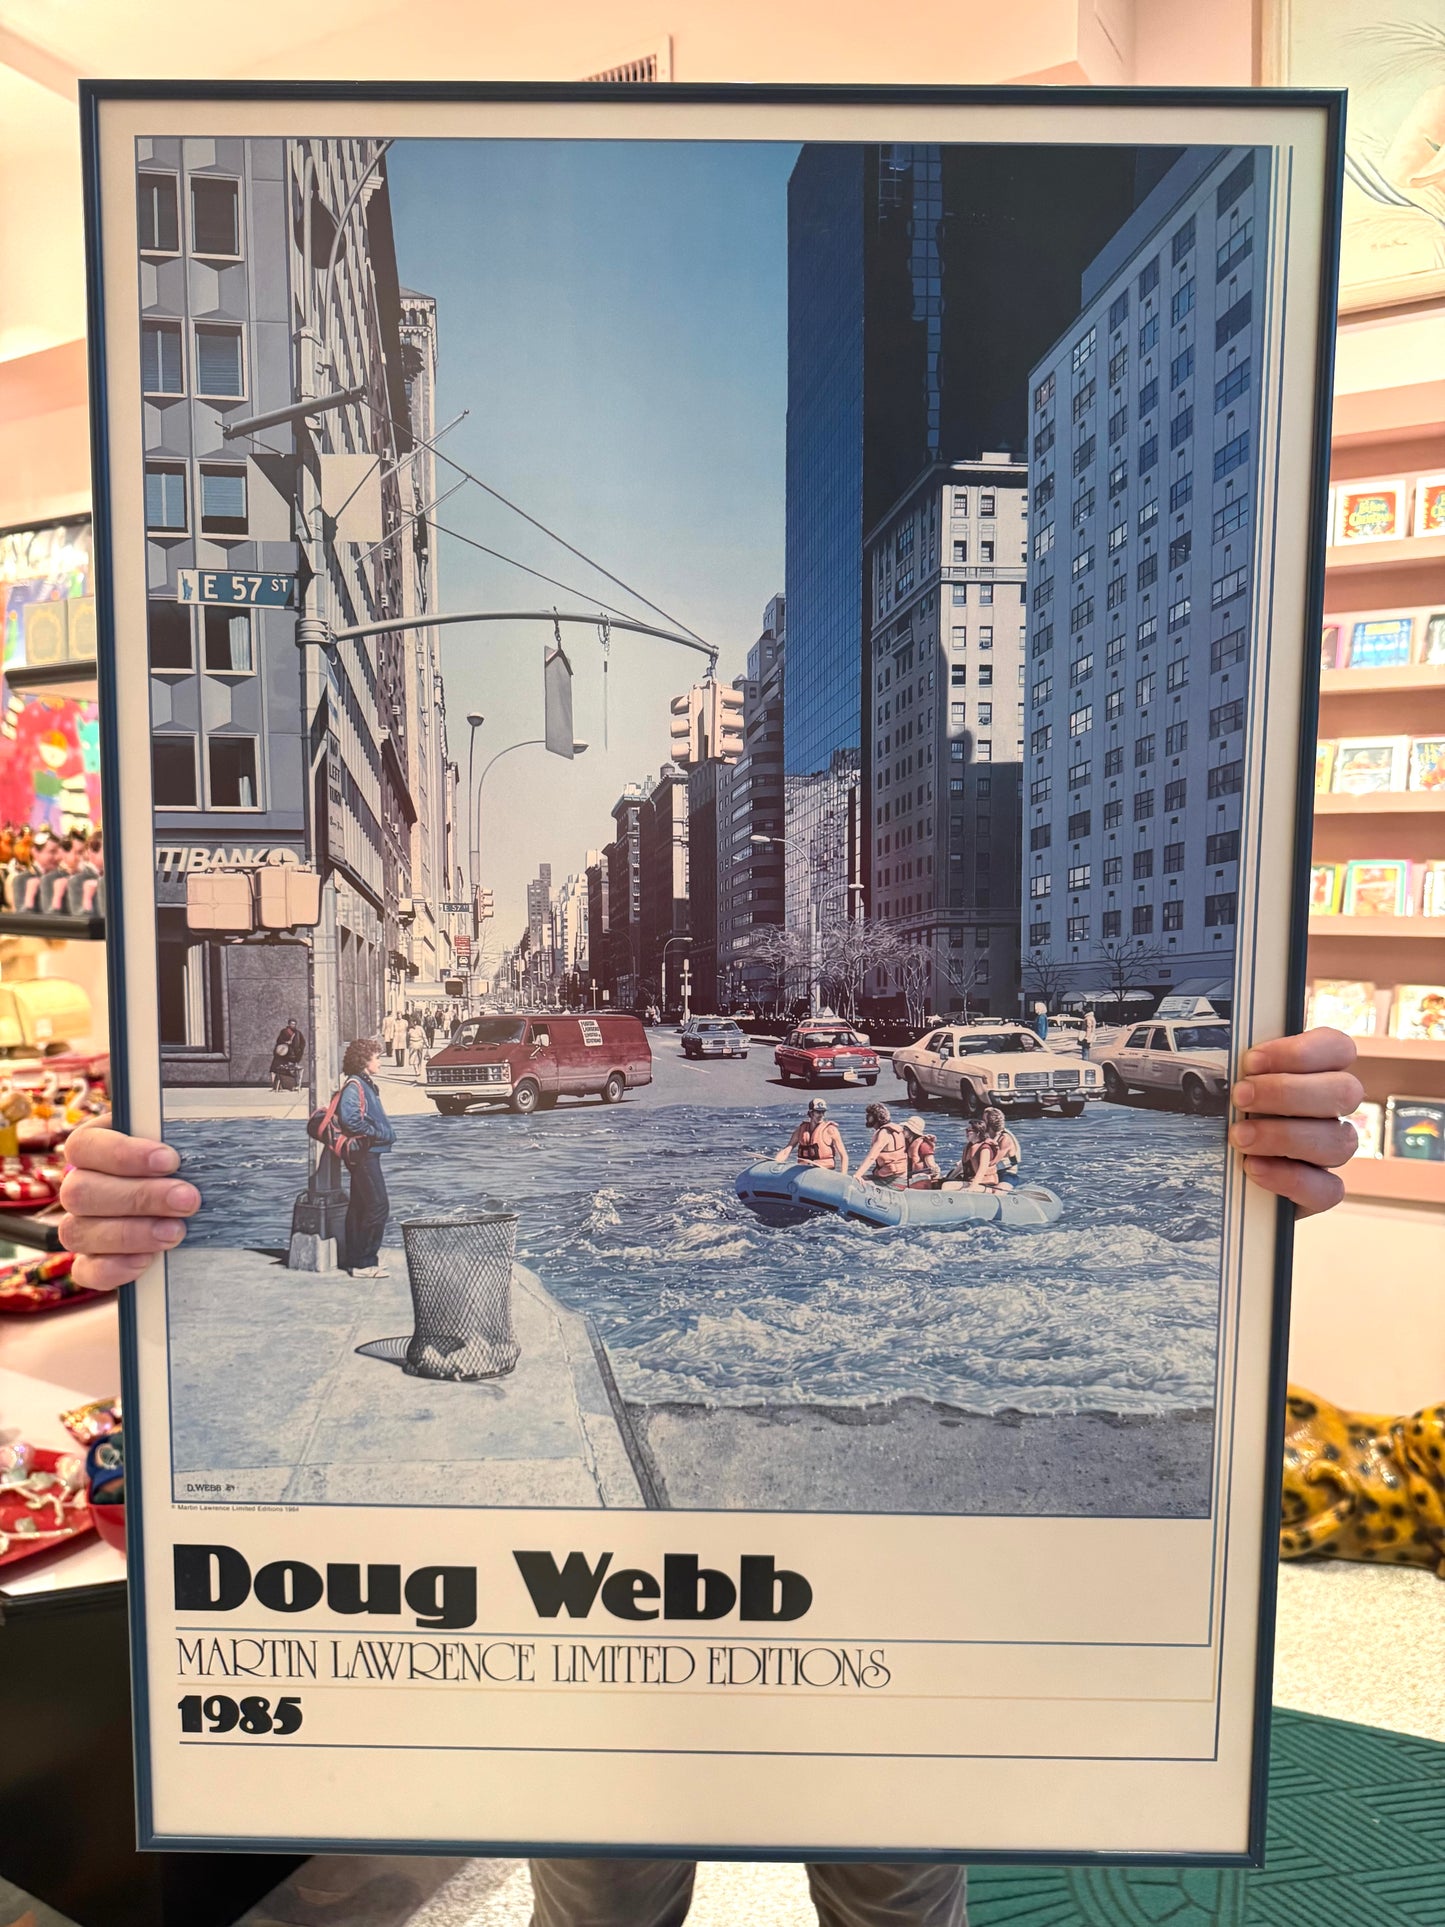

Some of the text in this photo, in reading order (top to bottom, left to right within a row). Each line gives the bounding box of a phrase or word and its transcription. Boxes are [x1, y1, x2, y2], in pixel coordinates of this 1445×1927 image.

[203, 575, 289, 602] E 57 ST
[329, 762, 340, 783] LEFT
[173, 1543, 813, 1630] Doug Webb
[176, 1637, 892, 1689] MARTIN LAWRENCE LIMITED EDITIONS
[177, 1694, 304, 1735] 1985
